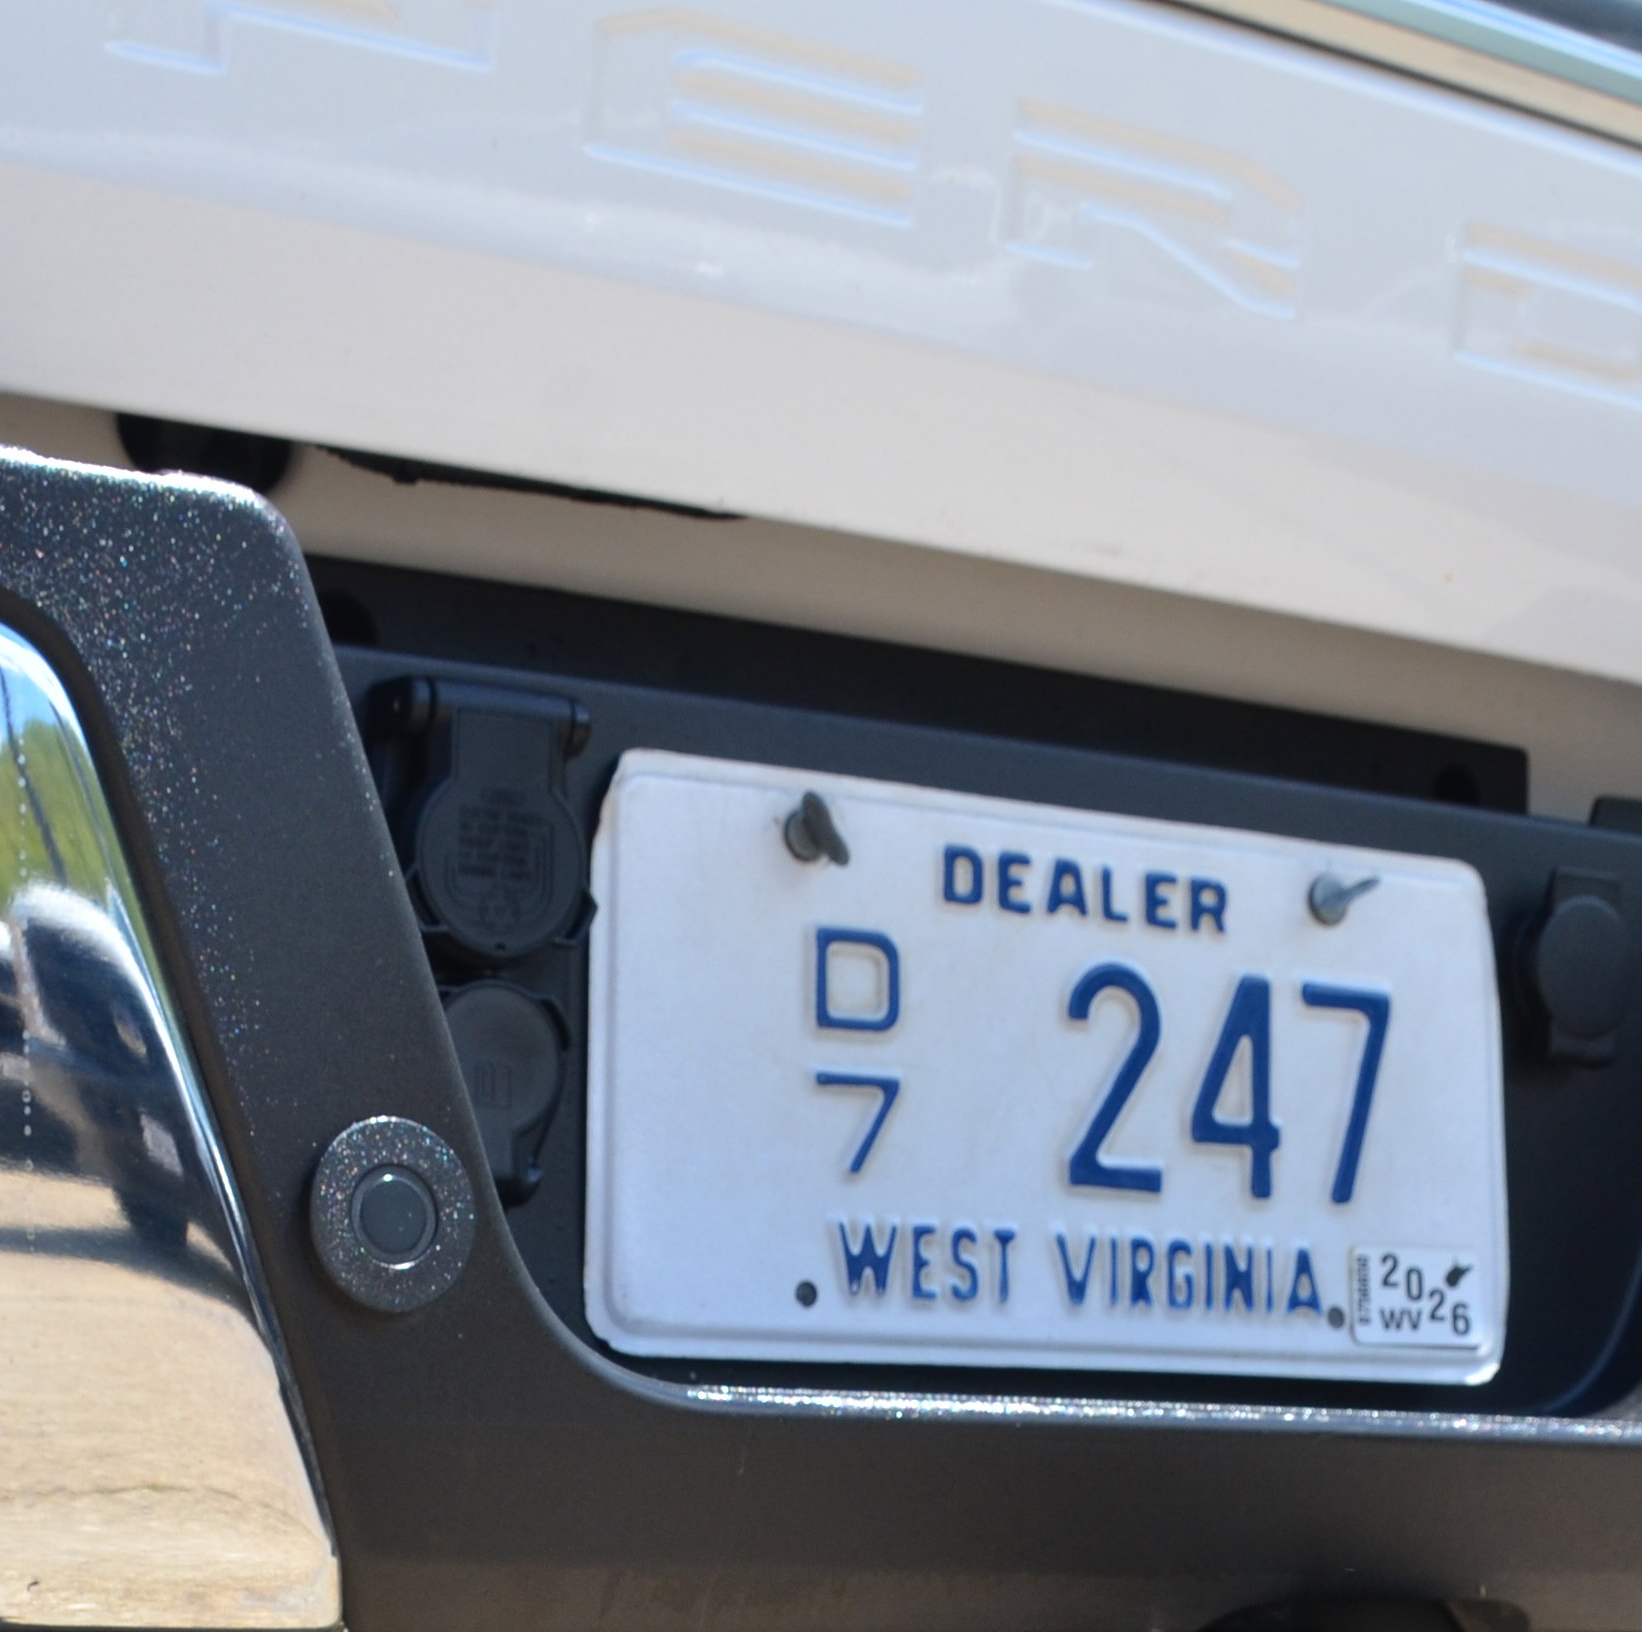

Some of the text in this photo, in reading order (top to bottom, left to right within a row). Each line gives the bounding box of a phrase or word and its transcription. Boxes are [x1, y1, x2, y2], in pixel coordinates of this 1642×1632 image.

[943, 844, 1227, 933] DEALER
[816, 927, 900, 1032] D
[815, 1072, 900, 1174] 7
[1068, 962, 1391, 1204] 247
[839, 1222, 1017, 1300] WEST
[1056, 1232, 1323, 1316] VIRGINIA
[1379, 1307, 1422, 1331] WV
